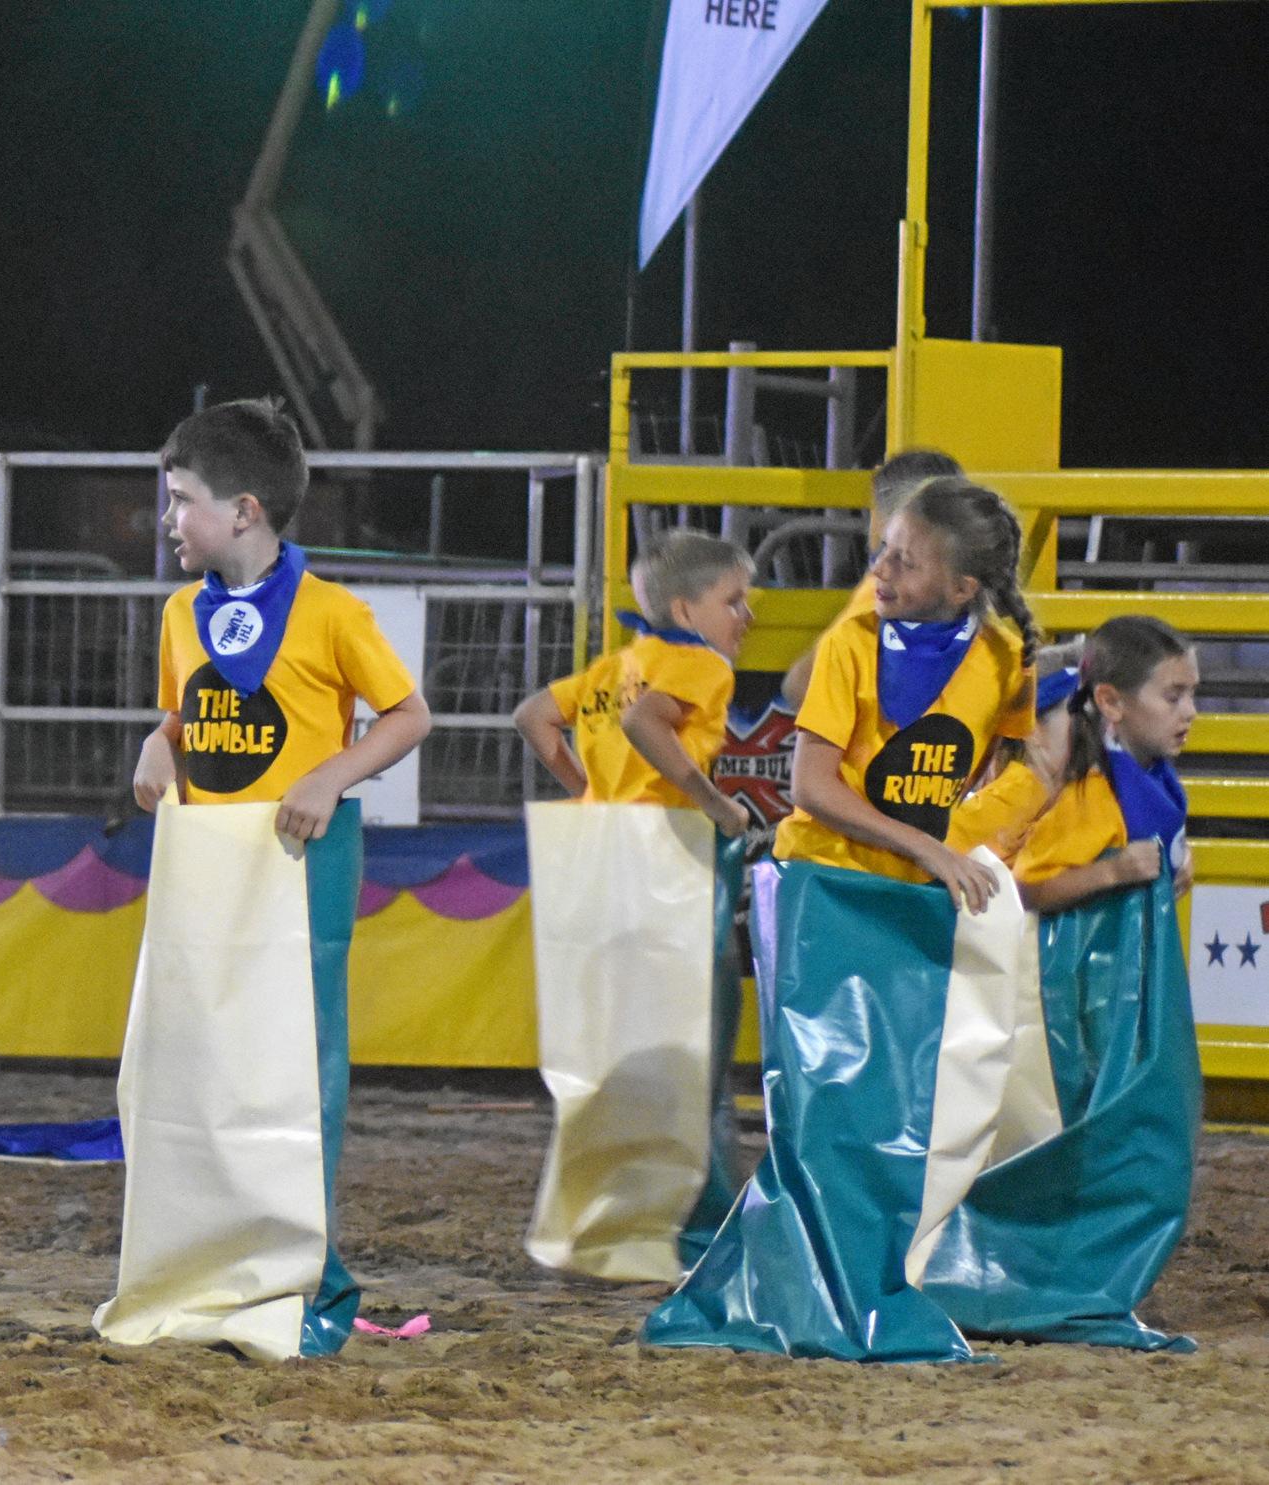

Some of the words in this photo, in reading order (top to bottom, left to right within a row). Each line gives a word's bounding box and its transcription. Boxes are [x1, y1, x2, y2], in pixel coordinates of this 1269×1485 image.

[705, 0, 777, 30] HERE
[217, 607, 246, 650] RUMBLE
[197, 687, 241, 719] THE
[183, 720, 276, 755] RUMBLE
[910, 742, 958, 773] THE
